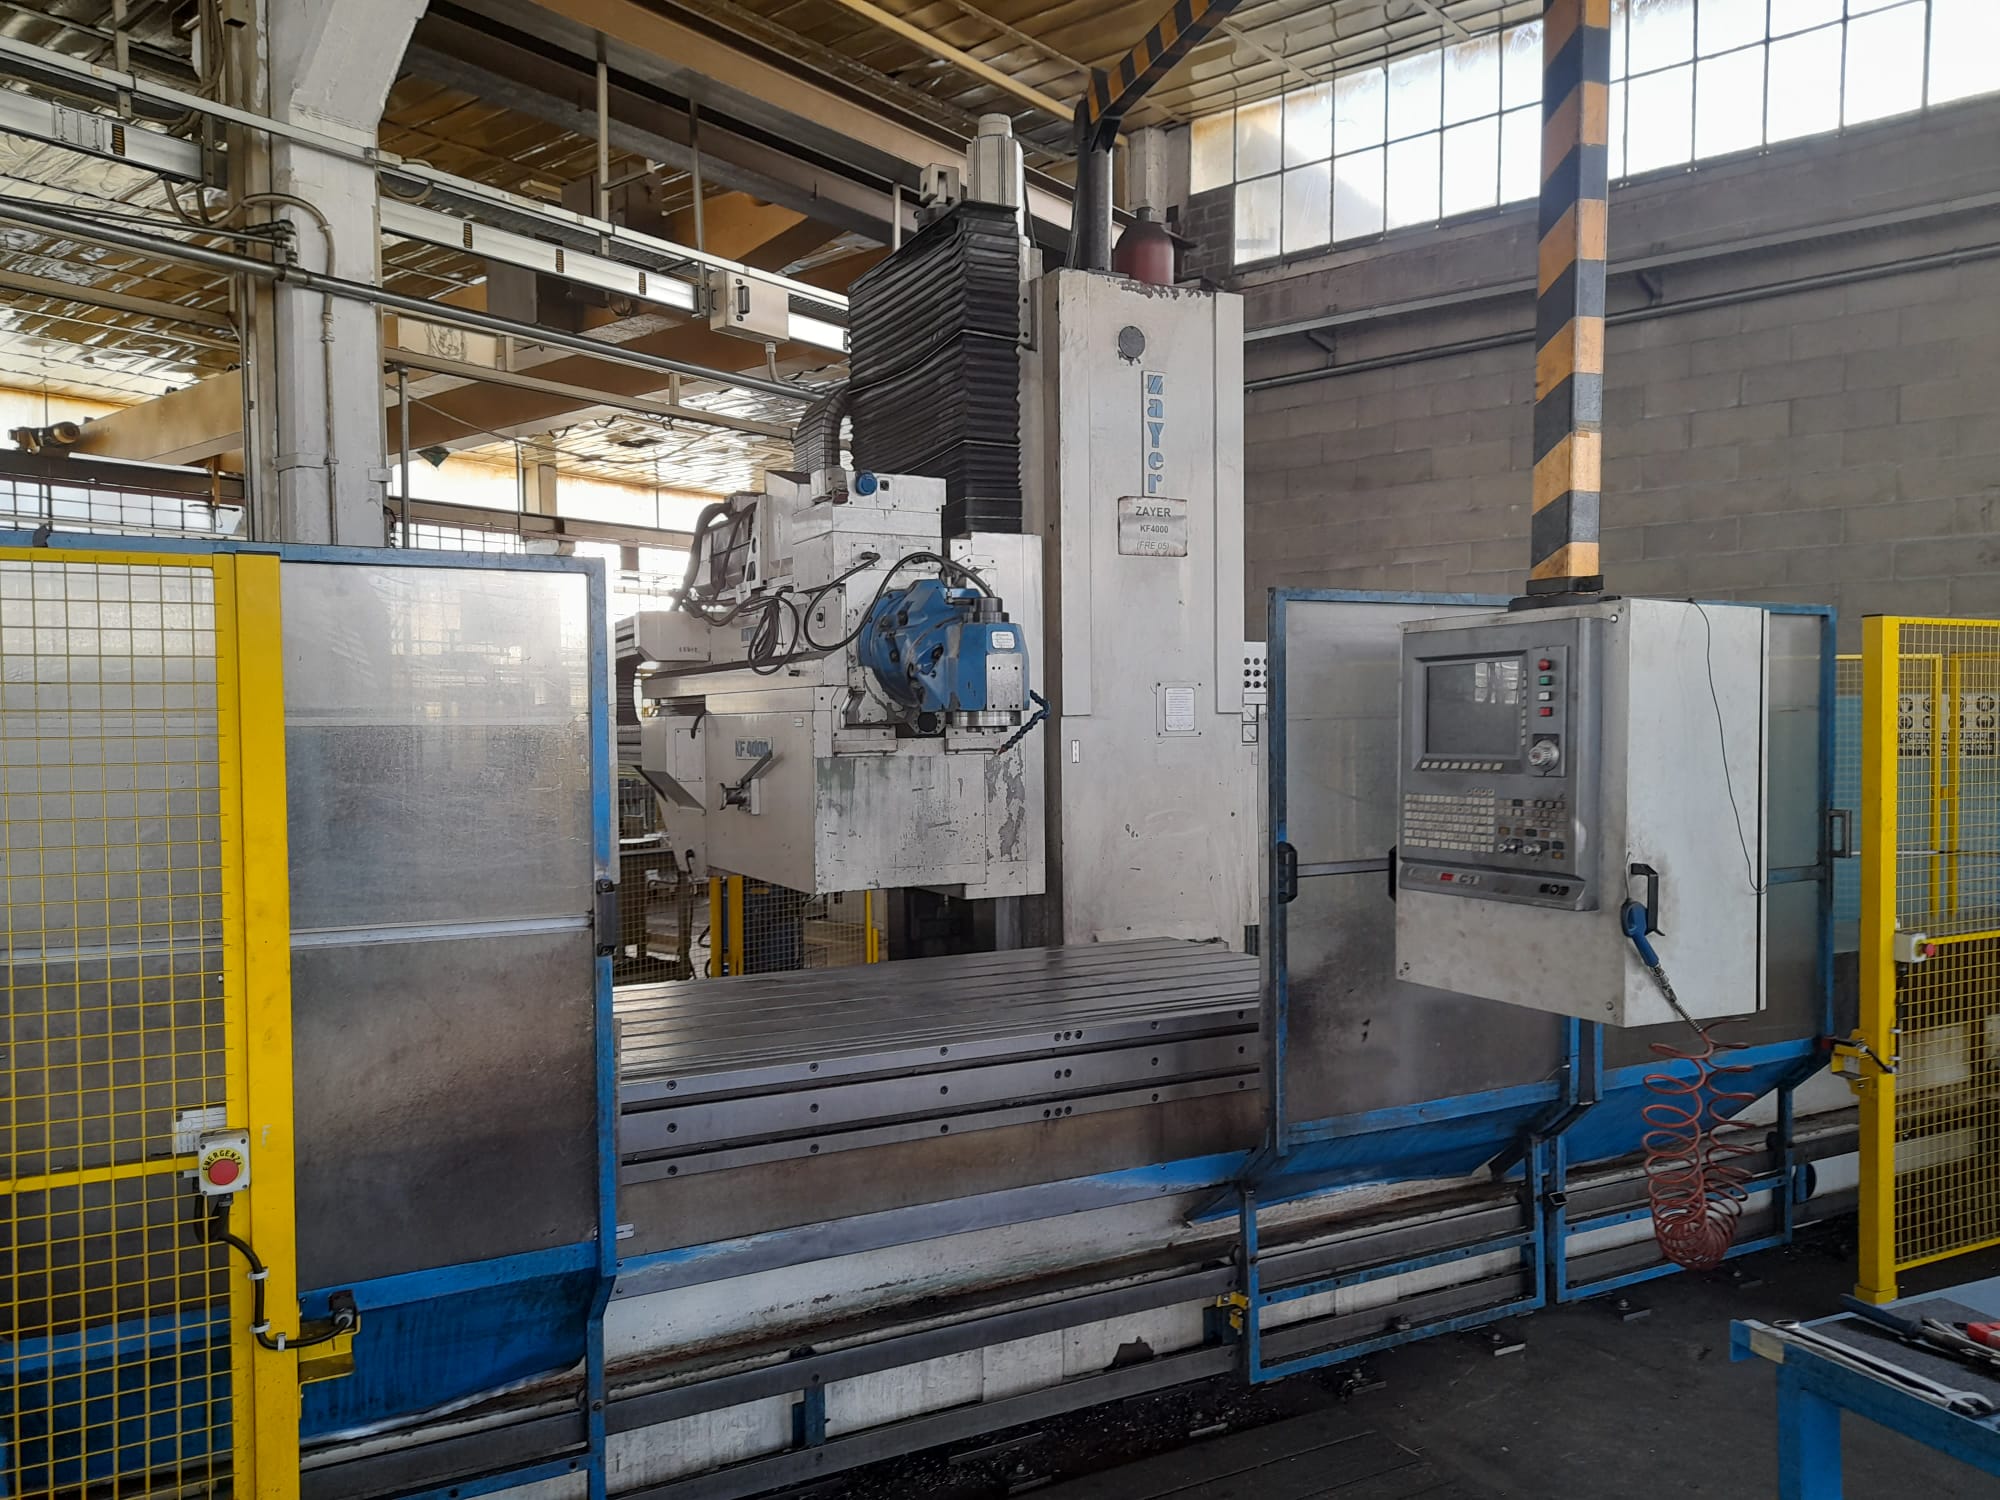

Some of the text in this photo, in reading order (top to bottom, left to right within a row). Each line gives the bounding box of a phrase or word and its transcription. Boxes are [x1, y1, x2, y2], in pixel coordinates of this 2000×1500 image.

[1135, 505, 1172, 517] ZAYER
[1140, 524, 1169, 534] KF4000
[1136, 540, 1156, 551] (FRE
[736, 740, 769, 758] KF 4000
